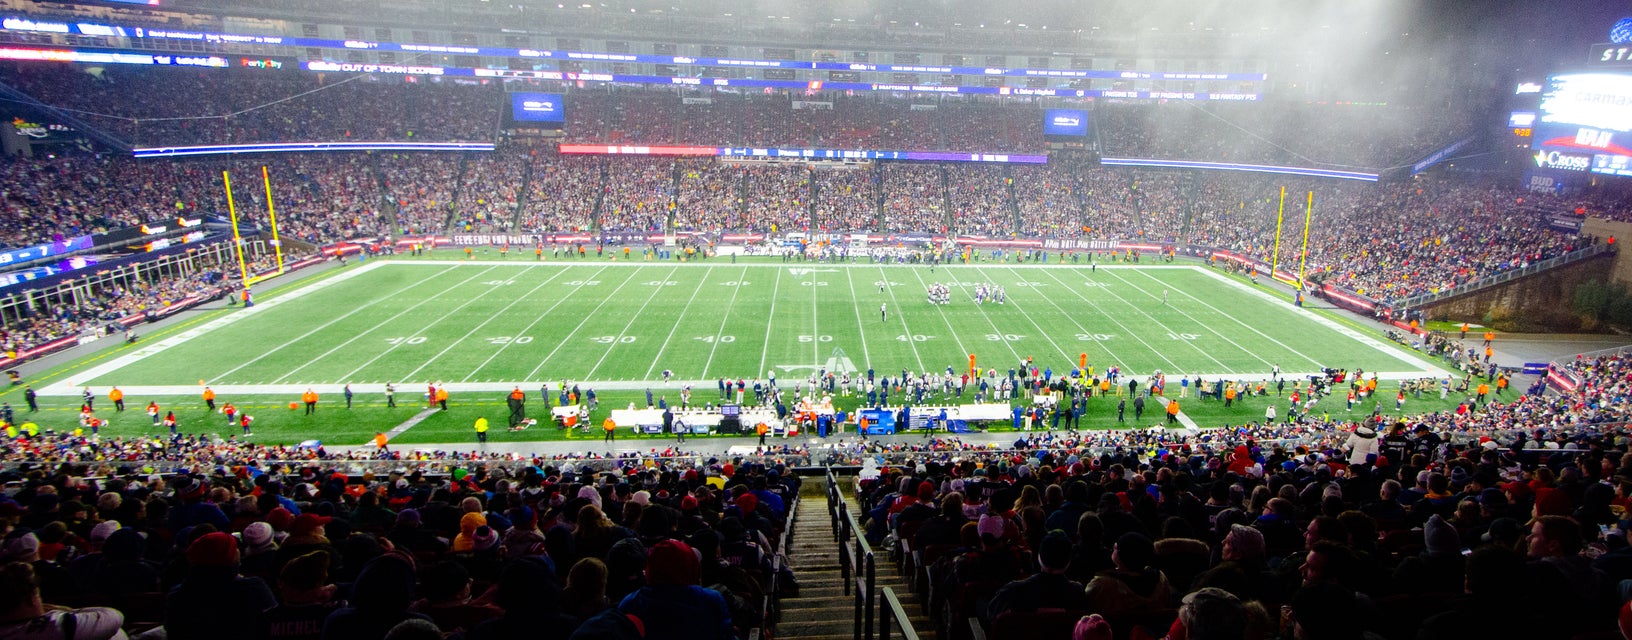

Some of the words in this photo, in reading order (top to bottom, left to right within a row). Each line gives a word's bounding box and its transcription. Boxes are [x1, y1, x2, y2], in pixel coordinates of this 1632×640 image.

[1575, 128, 1613, 148] REPLAY
[1531, 176, 1553, 186] BUD
[270, 620, 320, 637] MICHEL
